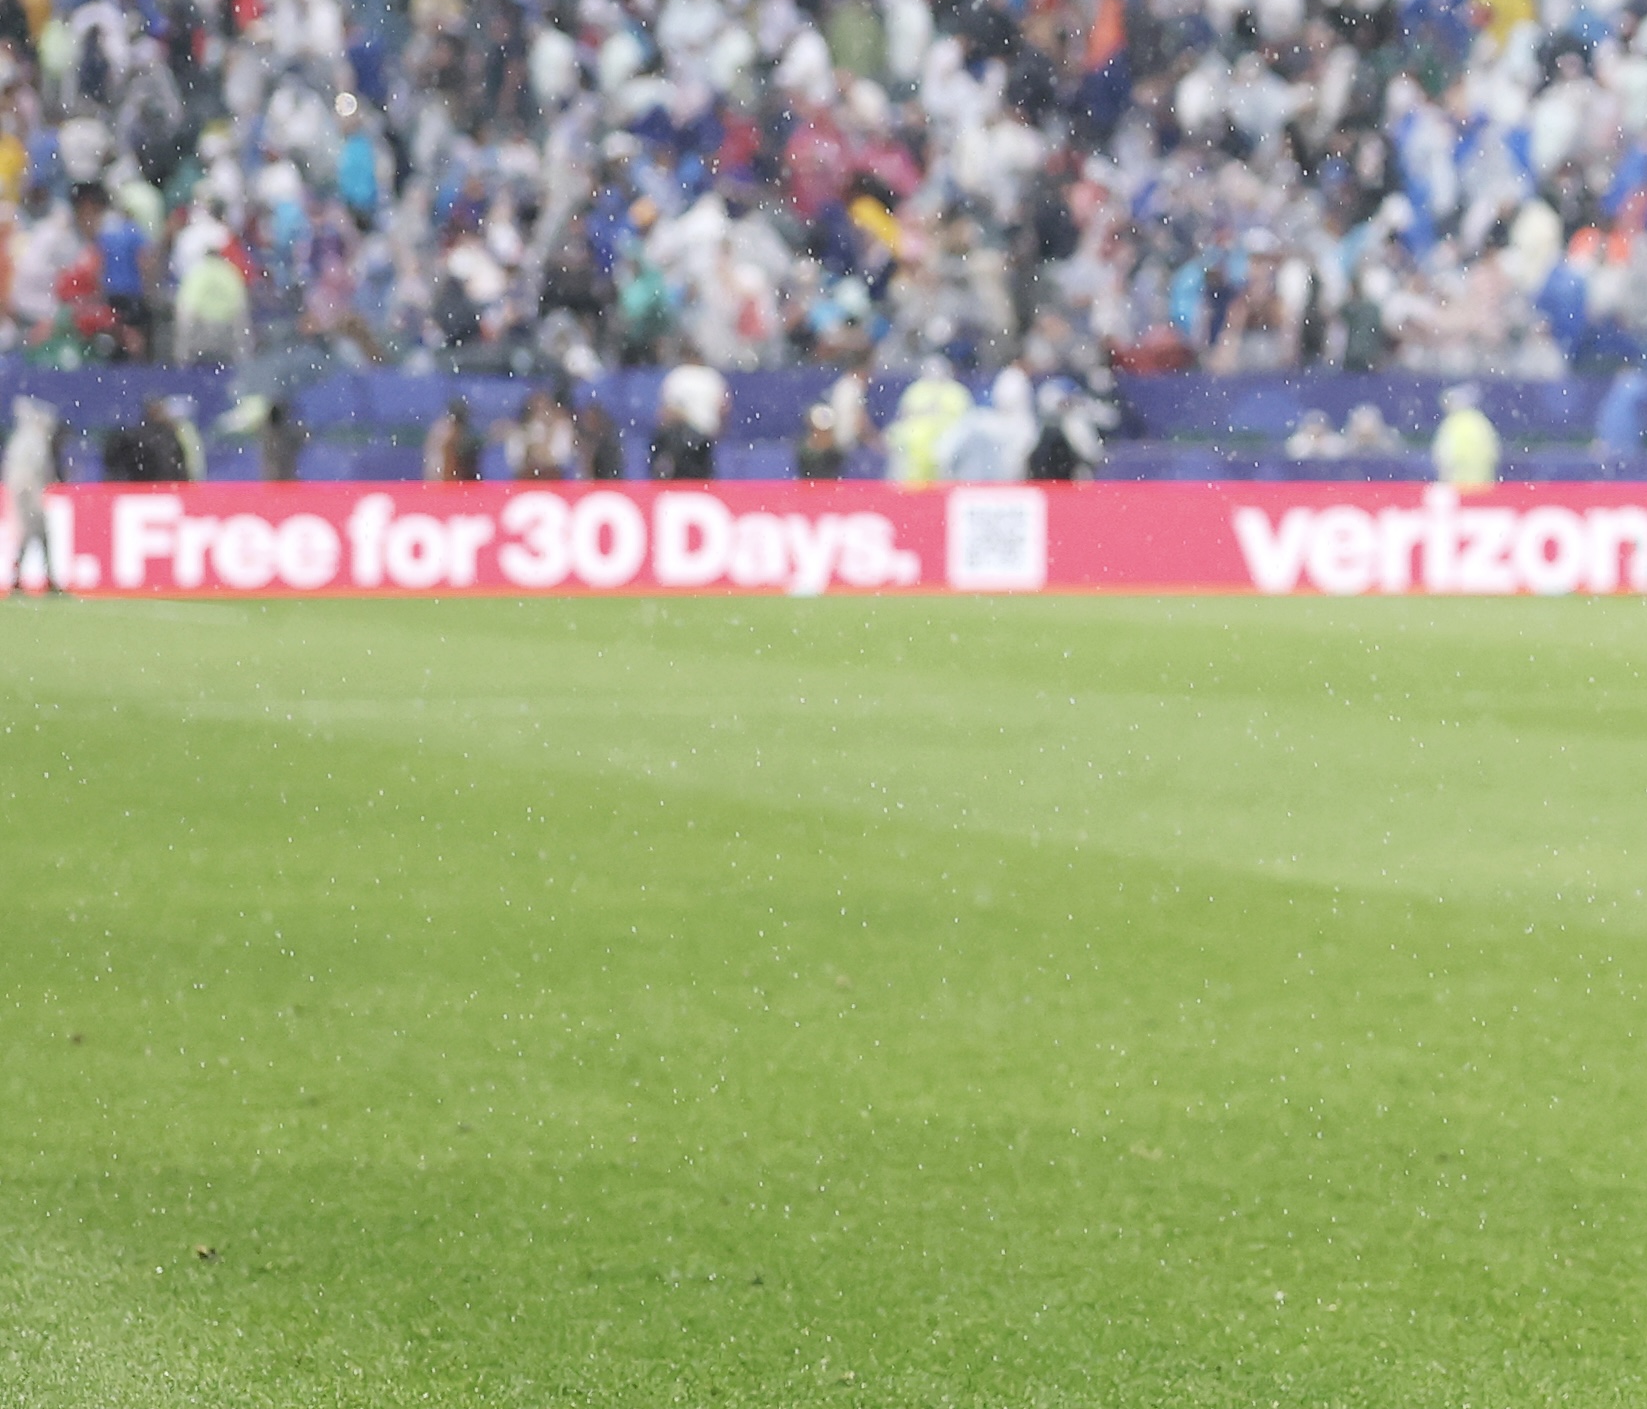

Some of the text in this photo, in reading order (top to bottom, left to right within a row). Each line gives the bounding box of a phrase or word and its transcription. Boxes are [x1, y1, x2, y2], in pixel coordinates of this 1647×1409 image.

[113, 494, 339, 589] Free
[350, 494, 493, 588] for
[501, 491, 648, 588] 30
[656, 494, 921, 595] Days.
